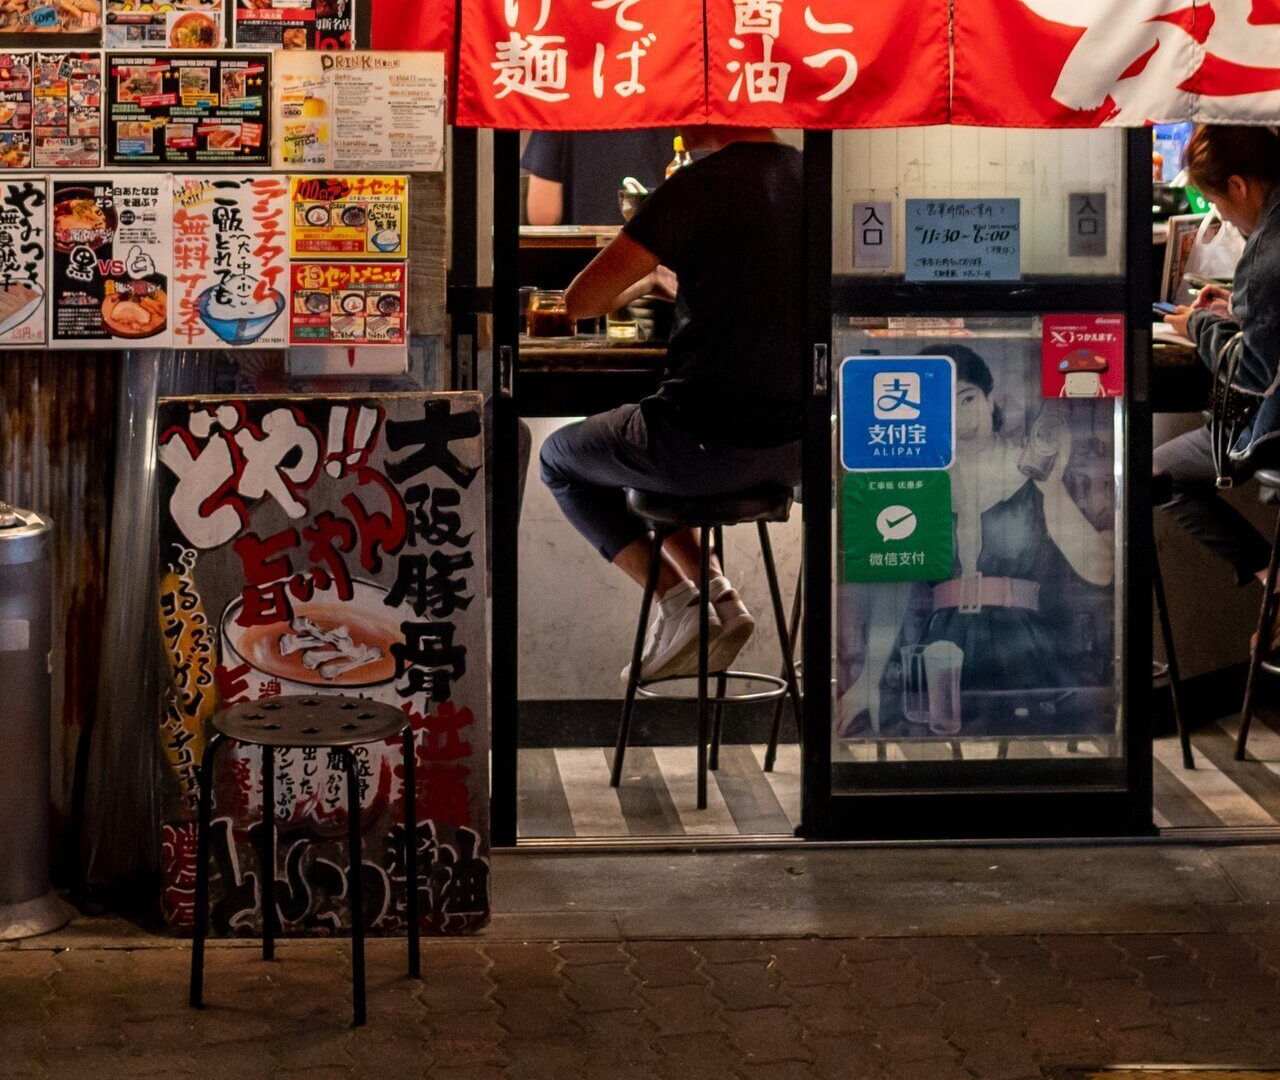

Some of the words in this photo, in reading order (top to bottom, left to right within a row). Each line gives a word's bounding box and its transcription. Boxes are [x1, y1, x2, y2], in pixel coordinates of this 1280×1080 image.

[320, 53, 372, 71] DRINK
[862, 206, 884, 246] 入口
[97, 259, 125, 276] VS
[868, 424, 927, 446] 支付宝
[873, 447, 922, 457] ALIPAY
[869, 550, 925, 567] 微信支付
